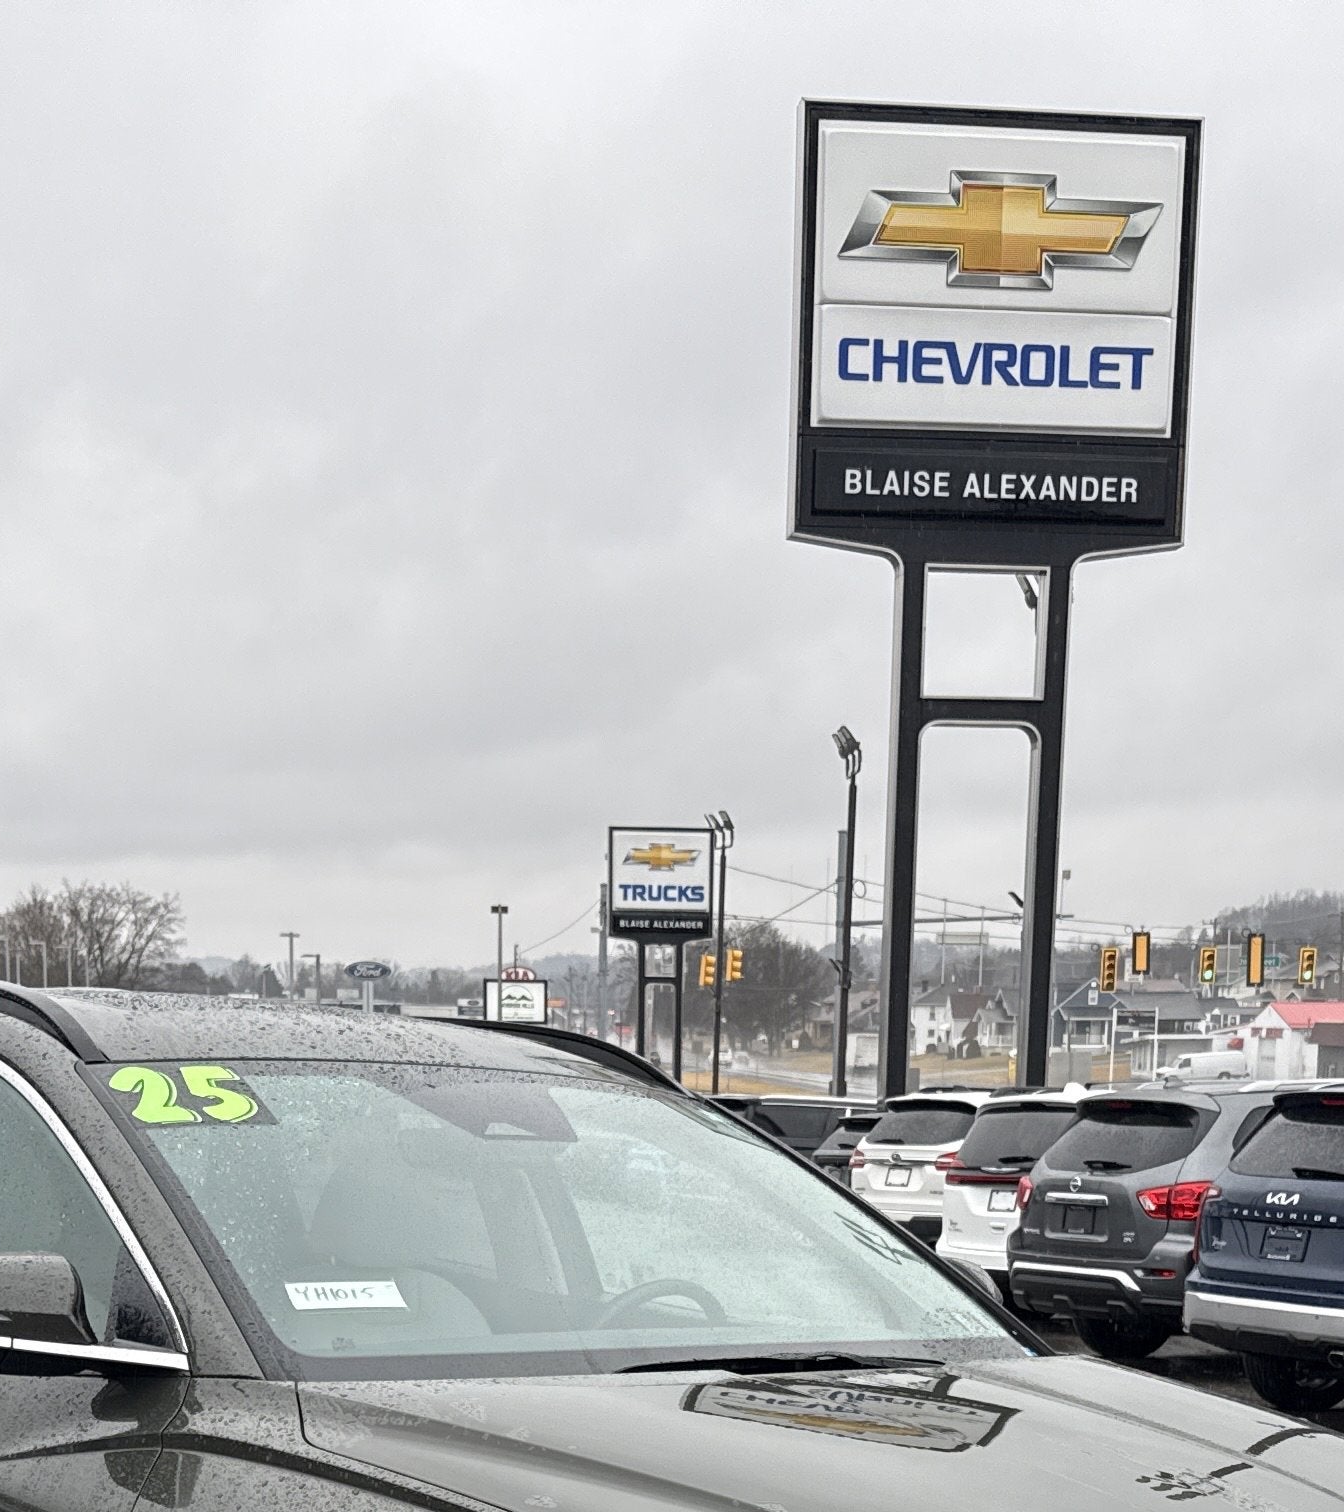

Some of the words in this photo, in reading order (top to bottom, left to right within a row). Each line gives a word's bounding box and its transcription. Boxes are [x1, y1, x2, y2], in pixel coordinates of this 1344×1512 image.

[838, 337, 1154, 390] CHEVROLET
[844, 468, 951, 497] BLAISE
[962, 473, 1138, 503] ALEXANDER
[618, 884, 705, 902] TRUCKS
[619, 919, 650, 928] BLAISE
[652, 920, 703, 930] ALEXANDER
[353, 964, 383, 978] Ford
[109, 1066, 259, 1124] 25
[1233, 1208, 1338, 1223] TELLURIDE
